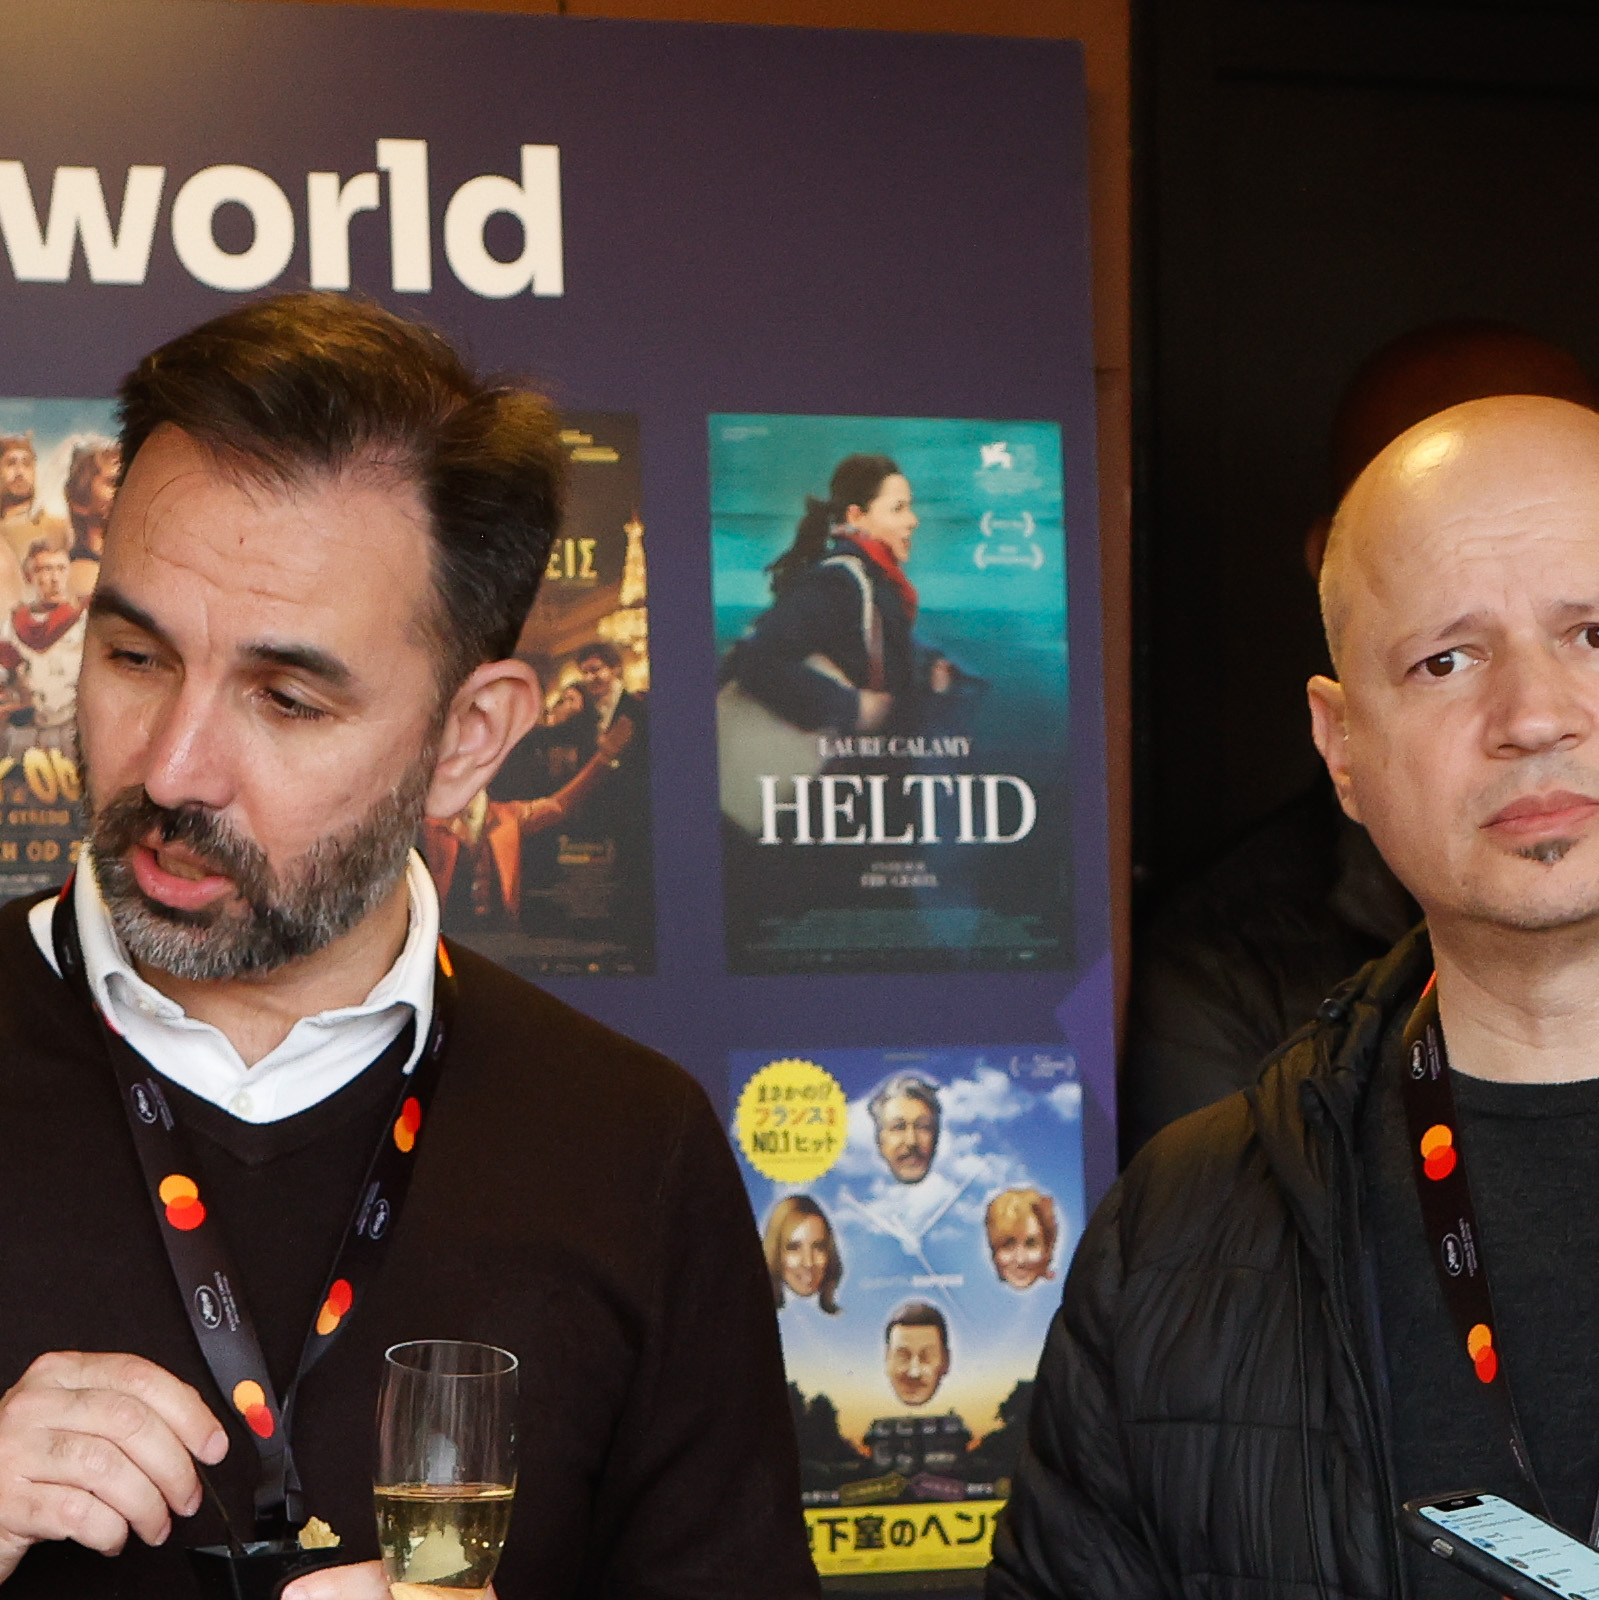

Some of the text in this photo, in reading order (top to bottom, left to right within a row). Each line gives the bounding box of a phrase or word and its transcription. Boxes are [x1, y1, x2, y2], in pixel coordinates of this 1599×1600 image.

[758, 773, 1038, 845] HELTID
[806, 1511, 997, 1553] 下室のヘン
